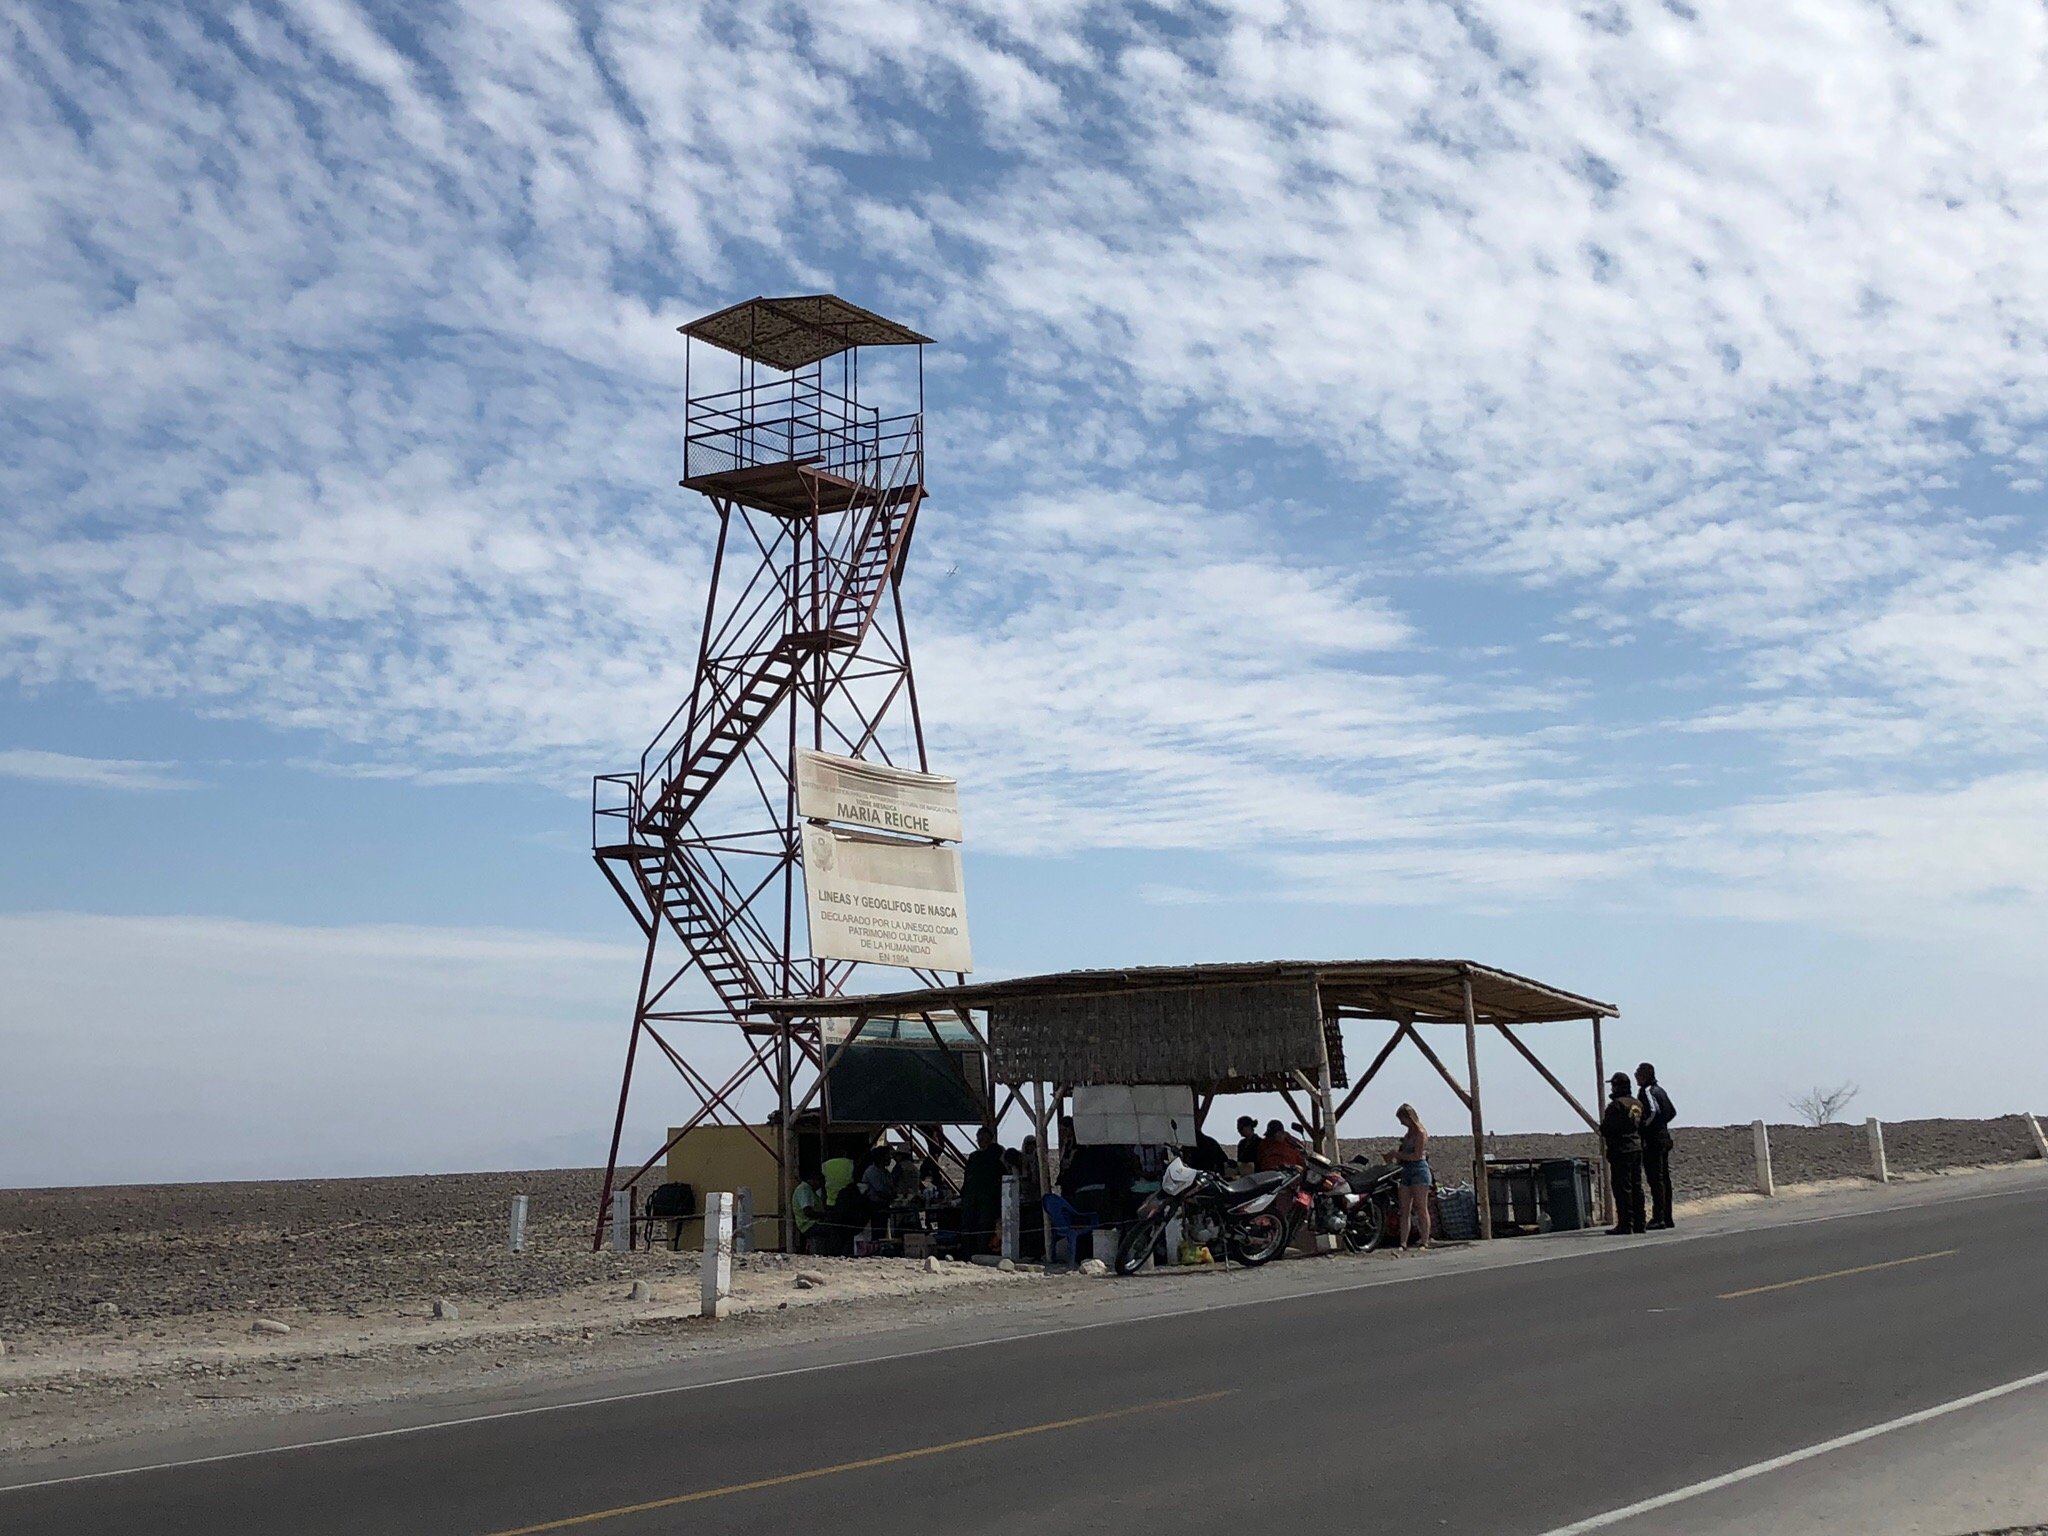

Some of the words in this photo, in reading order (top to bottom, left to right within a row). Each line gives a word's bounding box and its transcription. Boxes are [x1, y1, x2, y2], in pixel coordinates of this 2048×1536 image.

[837, 802, 881, 824] MARIA
[885, 810, 930, 832] REICHE
[818, 889, 851, 905] LINEAS
[853, 895, 859, 906] Y
[861, 896, 912, 914] GEOGLIFOS
[914, 903, 926, 915] DE
[928, 905, 957, 918] NASCA
[821, 911, 871, 925] DECLARADO
[872, 918, 889, 928] POR
[891, 920, 900, 929] LA
[901, 922, 934, 934] UNESCO
[935, 925, 959, 936] COMO
[849, 926, 897, 940] PATRIMONIO
[898, 932, 938, 945] CULTURAL
[860, 939, 871, 948] DE
[873, 941, 883, 949] LA
[884, 942, 931, 955] HUMANIDAD
[879, 952, 890, 962] EN
